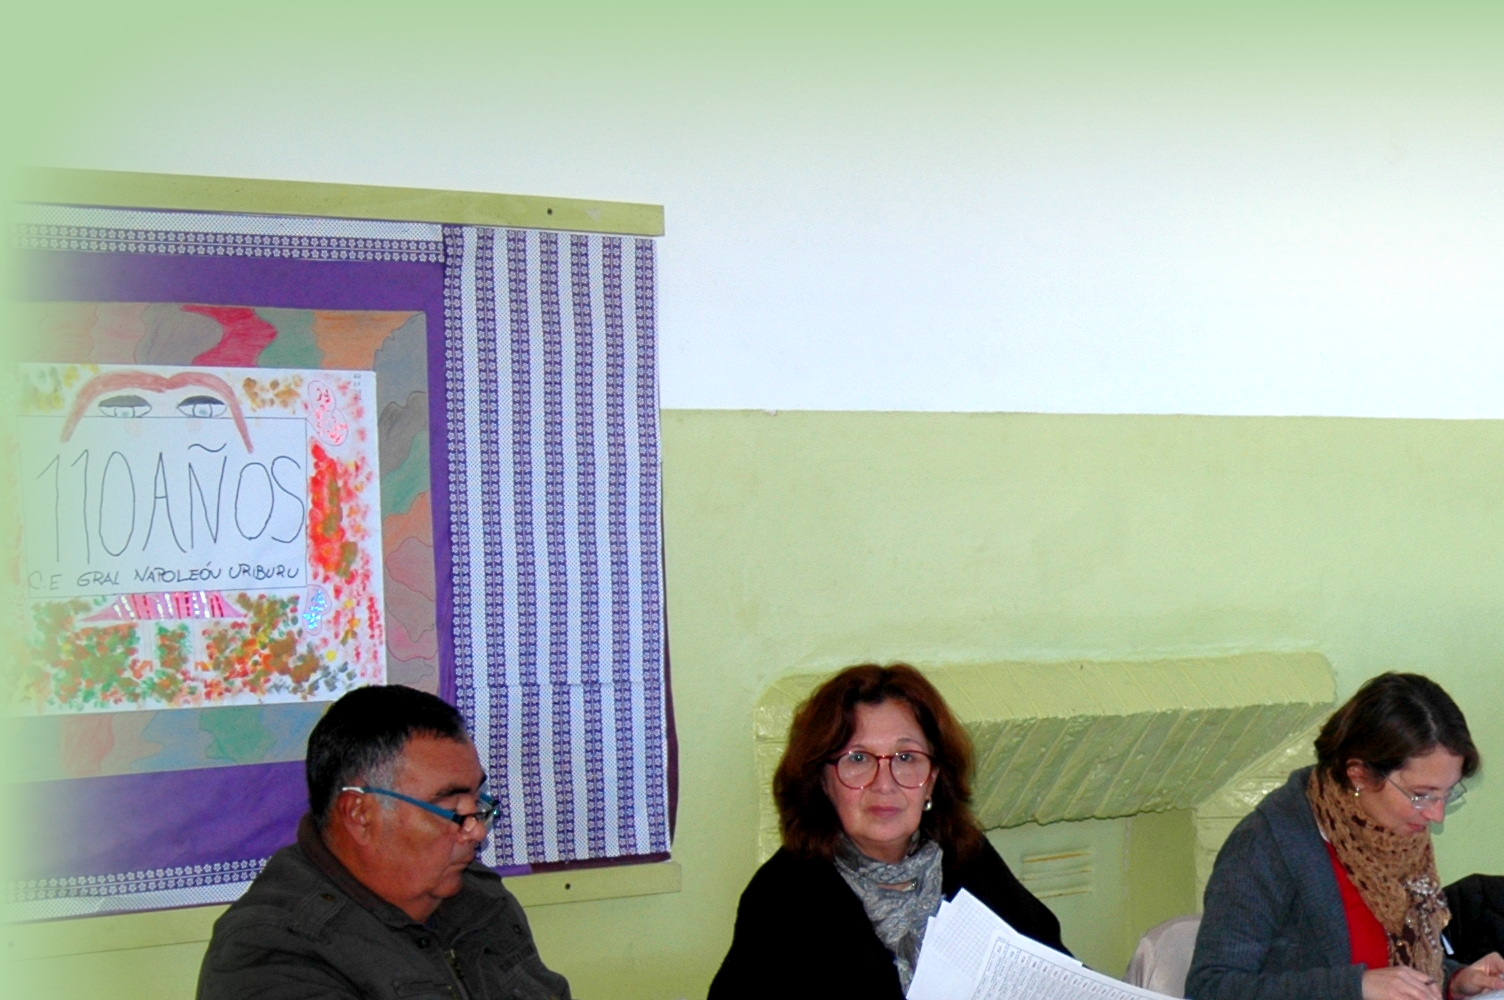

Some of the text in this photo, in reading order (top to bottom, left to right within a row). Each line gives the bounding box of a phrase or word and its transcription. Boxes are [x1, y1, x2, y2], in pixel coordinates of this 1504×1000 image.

[37, 443, 305, 564] 110 AÑOS
[134, 561, 222, 583] NAPOLEÓN
[228, 566, 300, 582] URIBURU
